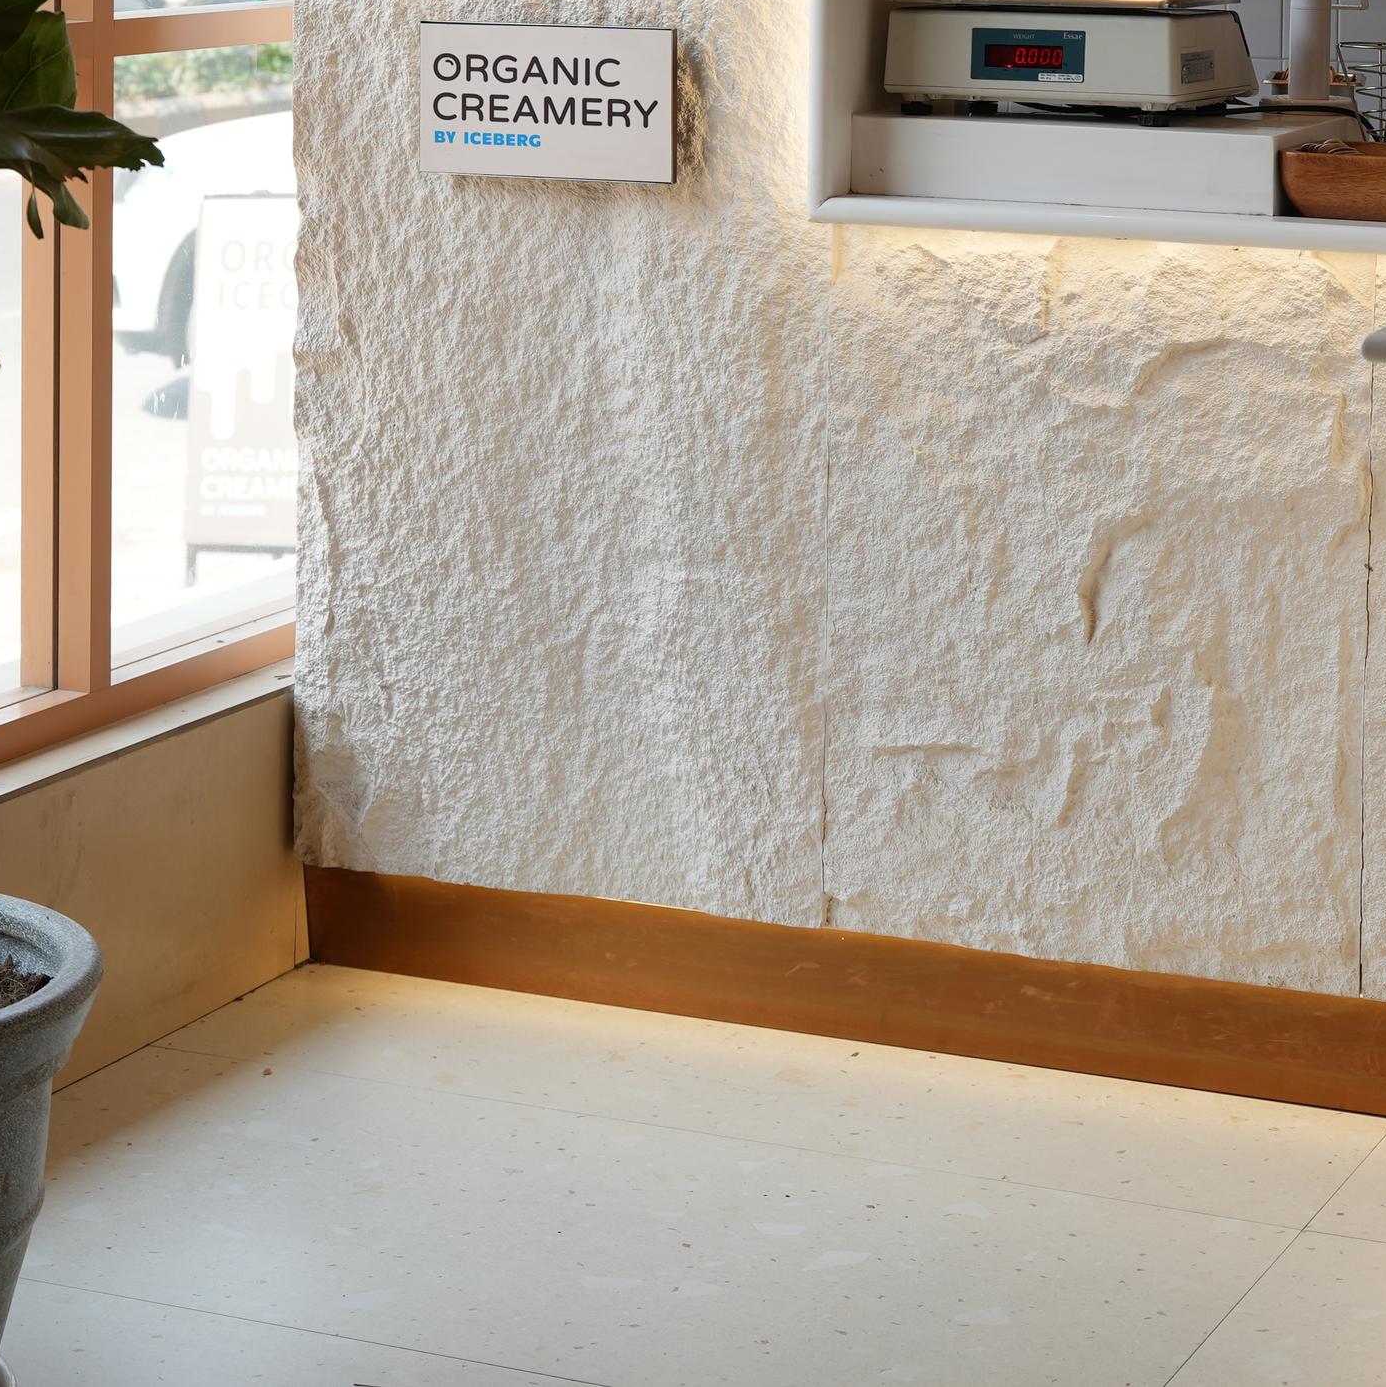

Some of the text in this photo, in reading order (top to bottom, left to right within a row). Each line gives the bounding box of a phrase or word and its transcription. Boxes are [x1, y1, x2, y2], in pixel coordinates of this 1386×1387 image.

[433, 53, 621, 87] ORGANIC
[433, 92, 658, 128] CREAMERY
[434, 130, 541, 147] BY ICEBERG
